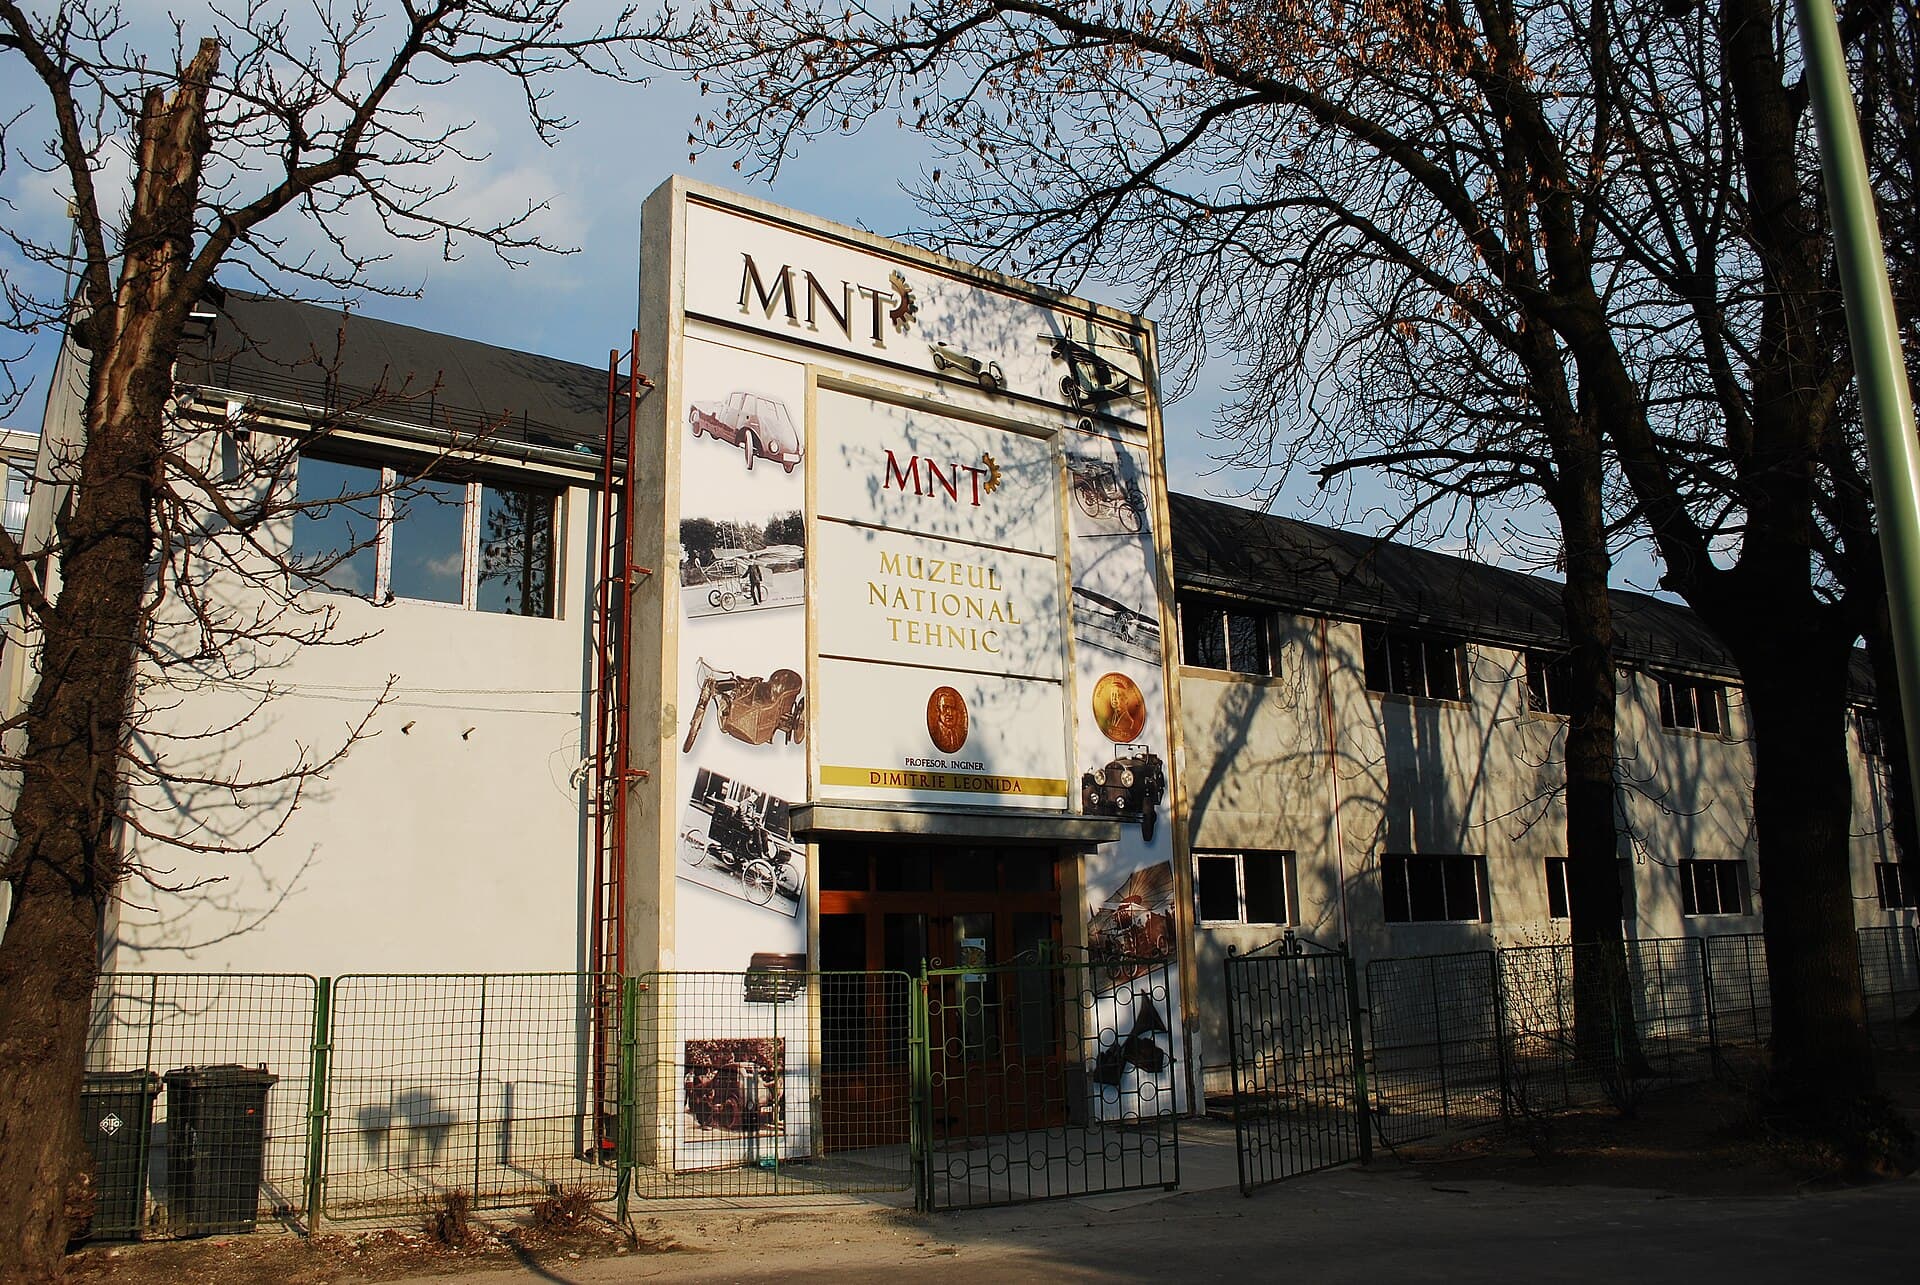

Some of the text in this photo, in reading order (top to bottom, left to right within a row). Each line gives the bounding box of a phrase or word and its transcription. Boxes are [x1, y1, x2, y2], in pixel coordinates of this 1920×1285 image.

[737, 252, 894, 342] MNT
[883, 449, 988, 507] MNT
[879, 551, 1002, 591] MUZEUL
[867, 581, 1021, 625] NATIONAL
[886, 617, 1001, 653] TEHNIC
[870, 771, 1022, 792] DIMITRIE LEONIDA
[905, 757, 985, 771] PROFESOR INGINER
